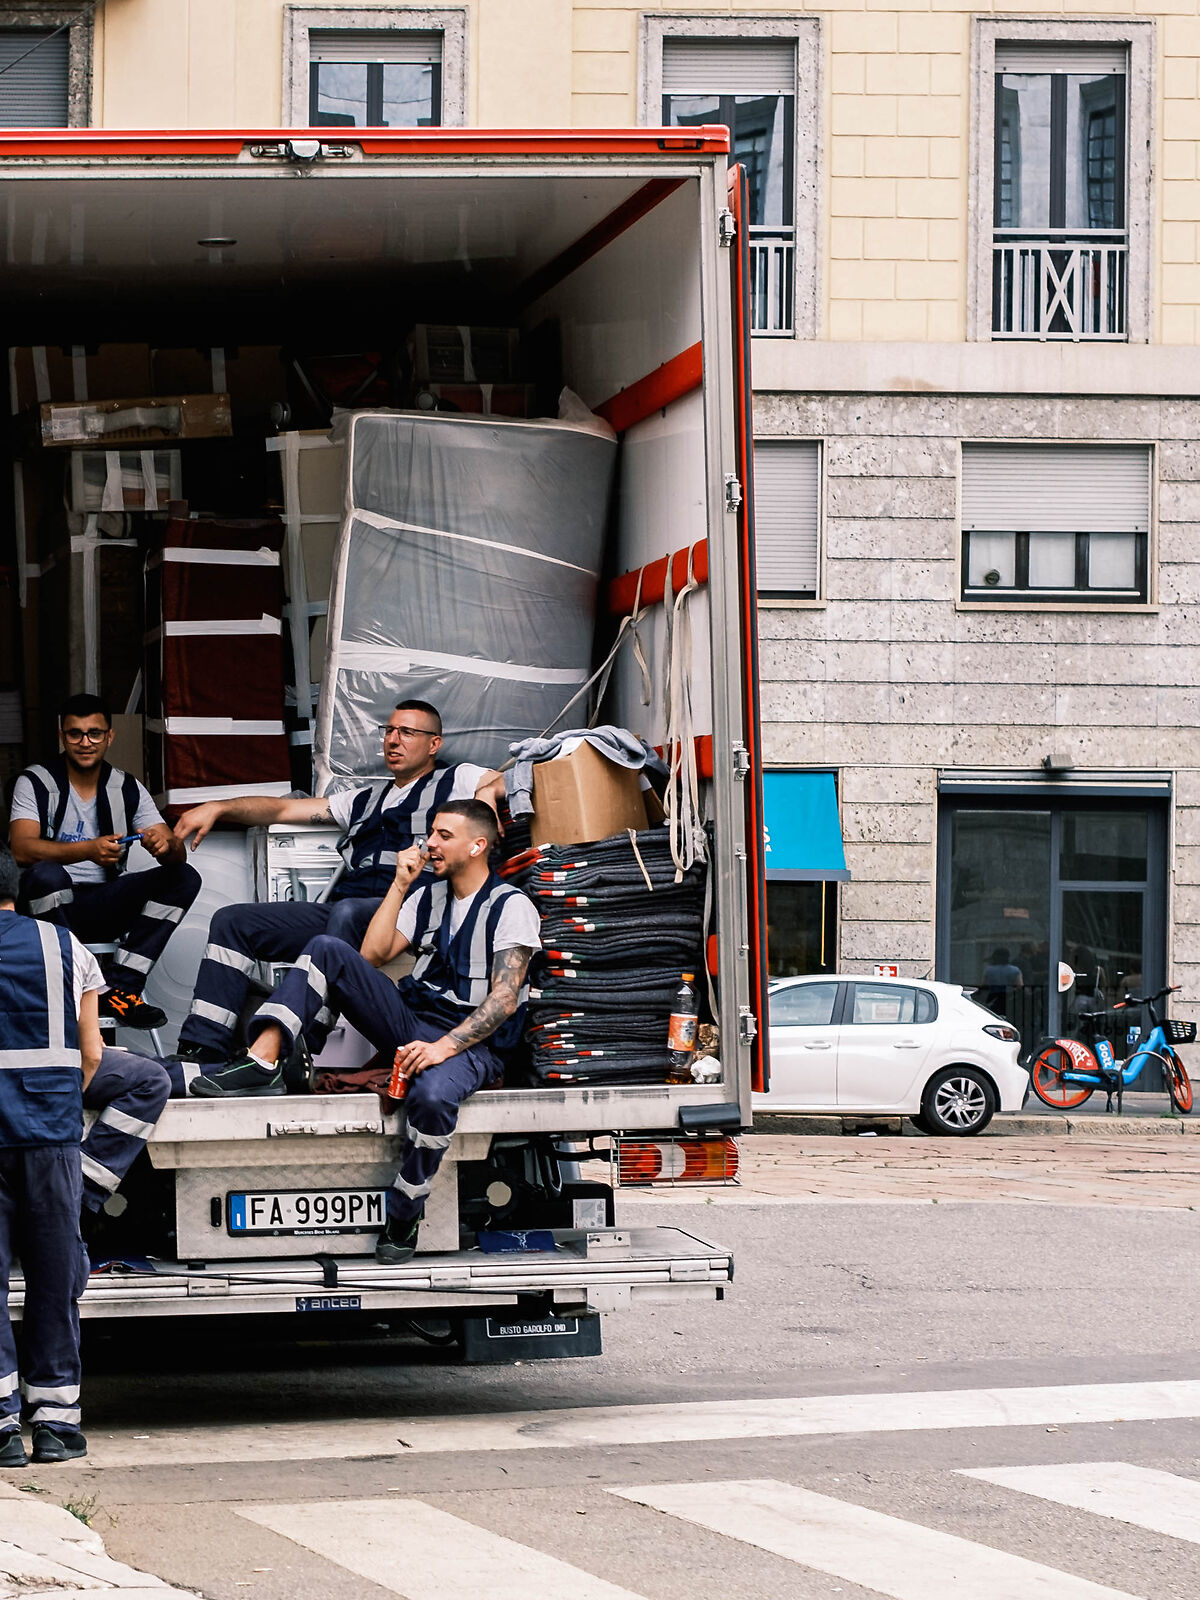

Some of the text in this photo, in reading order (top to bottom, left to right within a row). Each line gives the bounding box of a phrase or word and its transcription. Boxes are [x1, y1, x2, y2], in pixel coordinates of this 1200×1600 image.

[250, 1194, 382, 1225] FA 999PM
[500, 1326, 522, 1335] BUSTO
